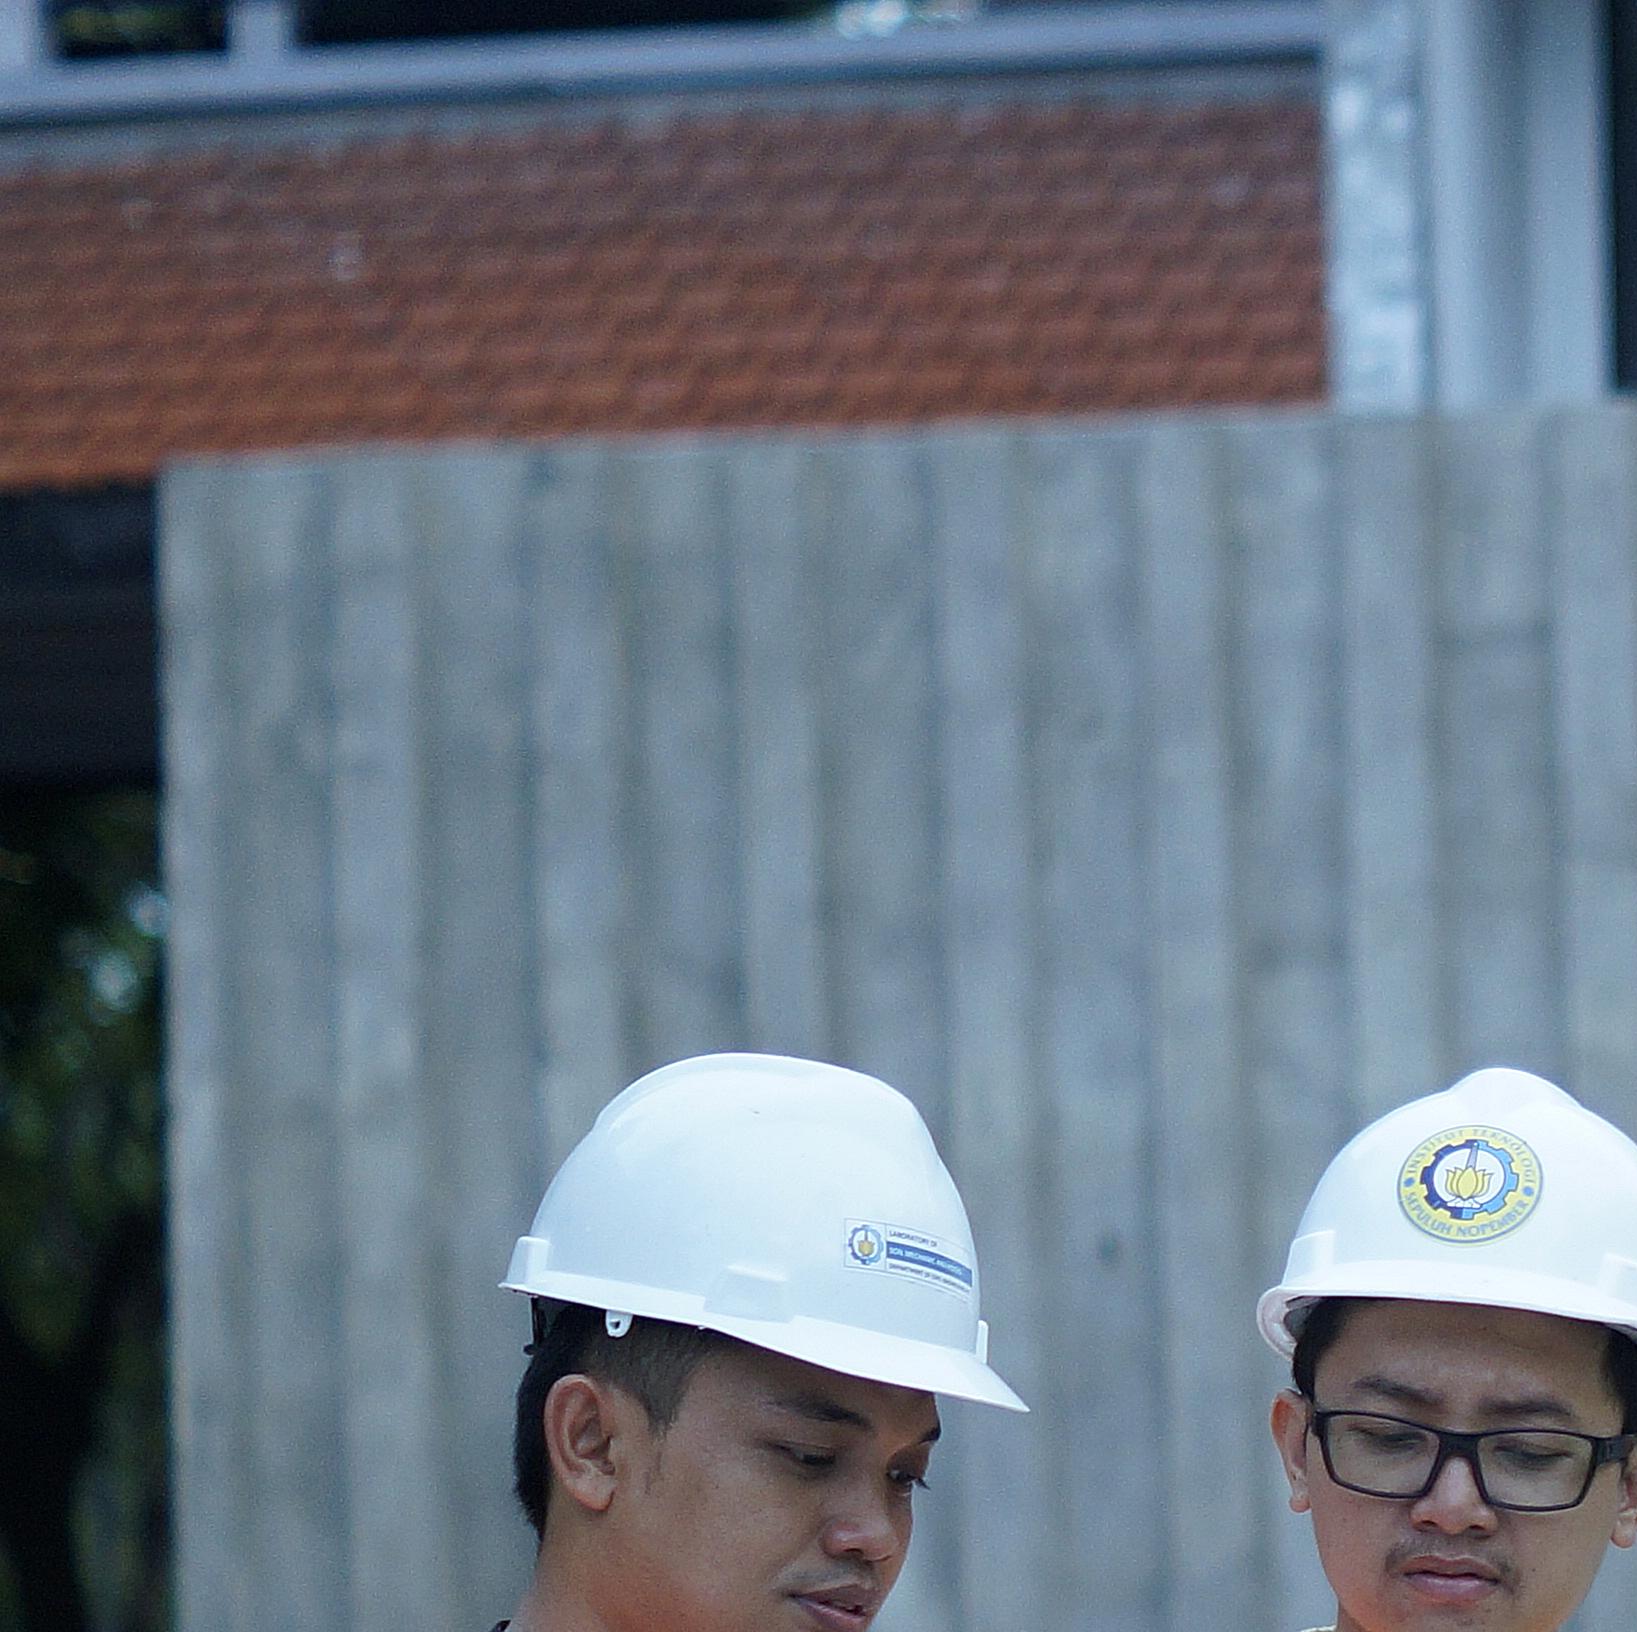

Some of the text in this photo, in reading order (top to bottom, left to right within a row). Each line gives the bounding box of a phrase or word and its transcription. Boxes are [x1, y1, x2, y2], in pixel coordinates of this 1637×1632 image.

[1407, 1128, 1536, 1185] INSTITUT TEKNOLOGI
[1404, 1191, 1529, 1238] SEPULUH NOPEMBER
